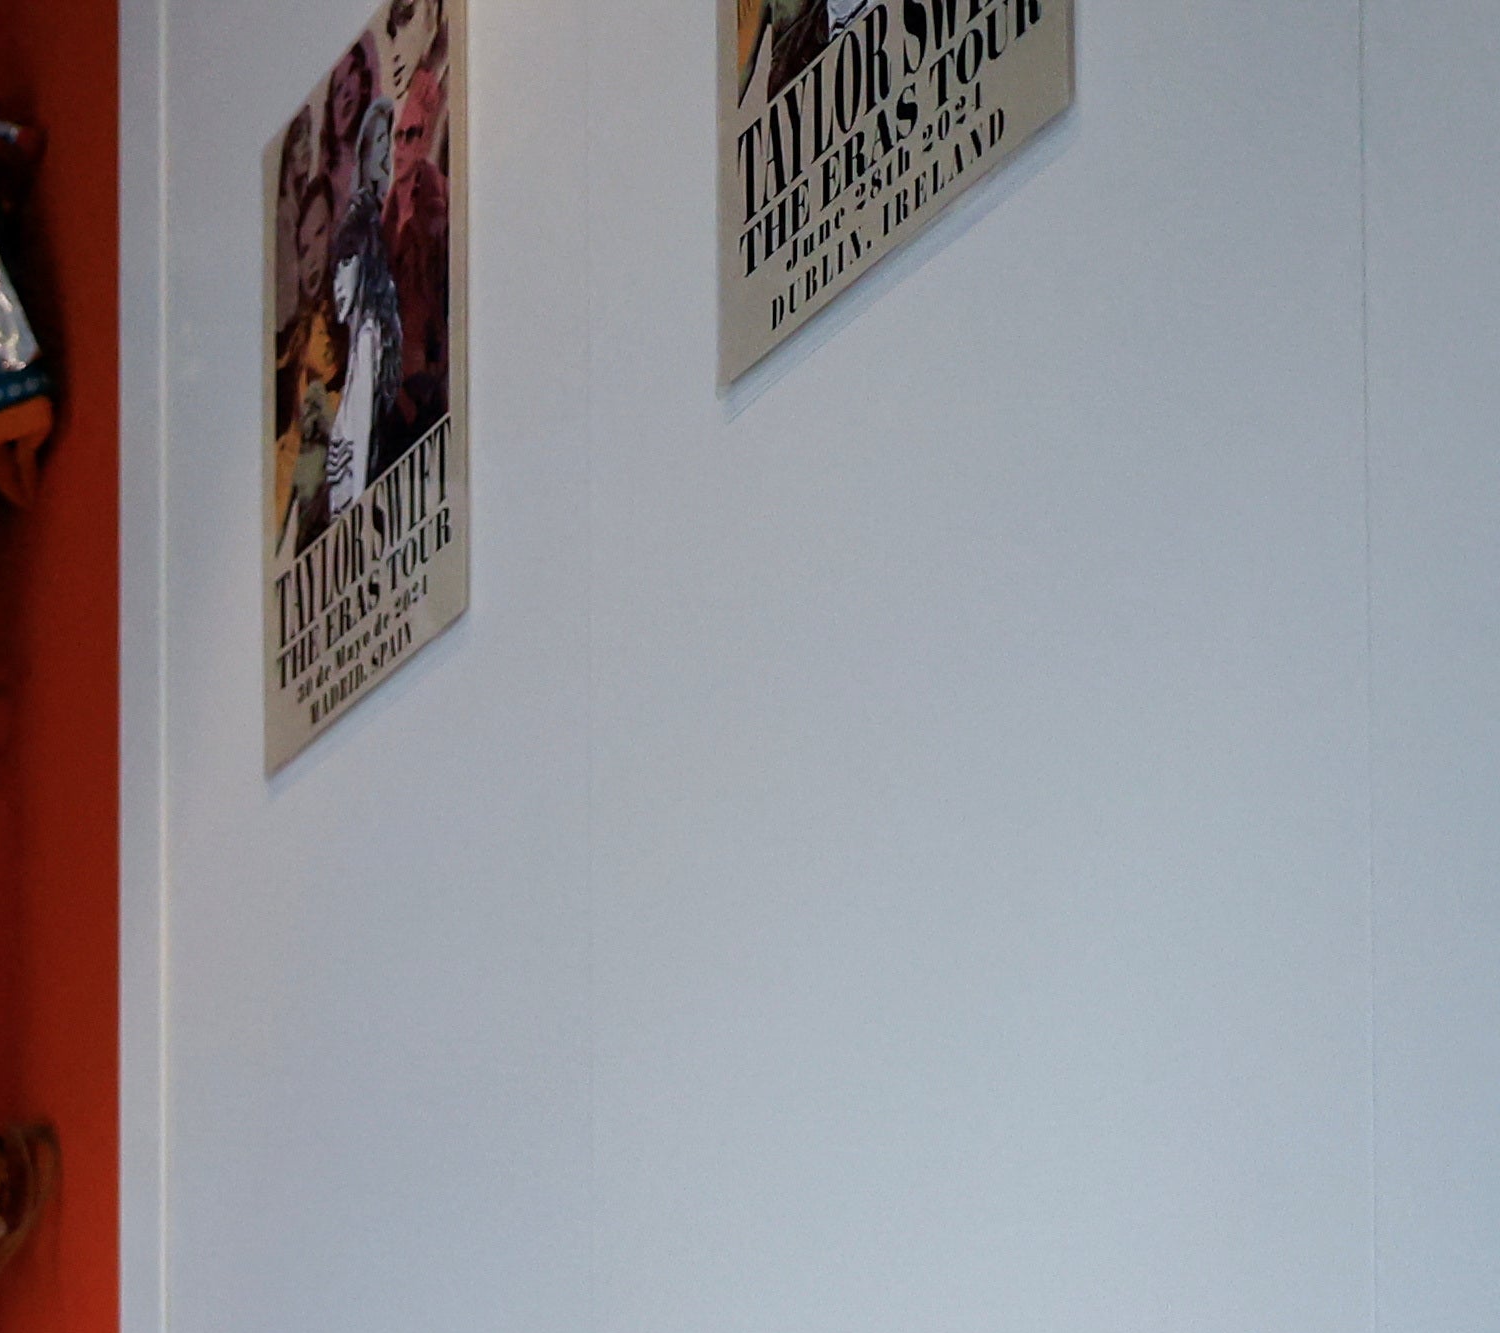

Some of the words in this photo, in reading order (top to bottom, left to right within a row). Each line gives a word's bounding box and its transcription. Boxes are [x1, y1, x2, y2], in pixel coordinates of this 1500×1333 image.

[738, 3, 890, 225] TAYLOR
[739, 179, 810, 278] THE
[820, 83, 918, 212] ERAS
[930, 0, 1041, 112] TOUR
[883, 108, 1005, 236] IRELAND
[786, 204, 845, 272] June
[855, 147, 910, 212] 28th
[276, 503, 364, 648] TAYLOR
[372, 422, 450, 562] SWIFT
[277, 631, 319, 690] THE
[326, 570, 380, 650] ERAS
[386, 507, 450, 591] TOUR
[316, 662, 331, 684] de
[335, 632, 371, 671] Mayo
[374, 610, 389, 636] de
[372, 621, 412, 675] SPAIN
